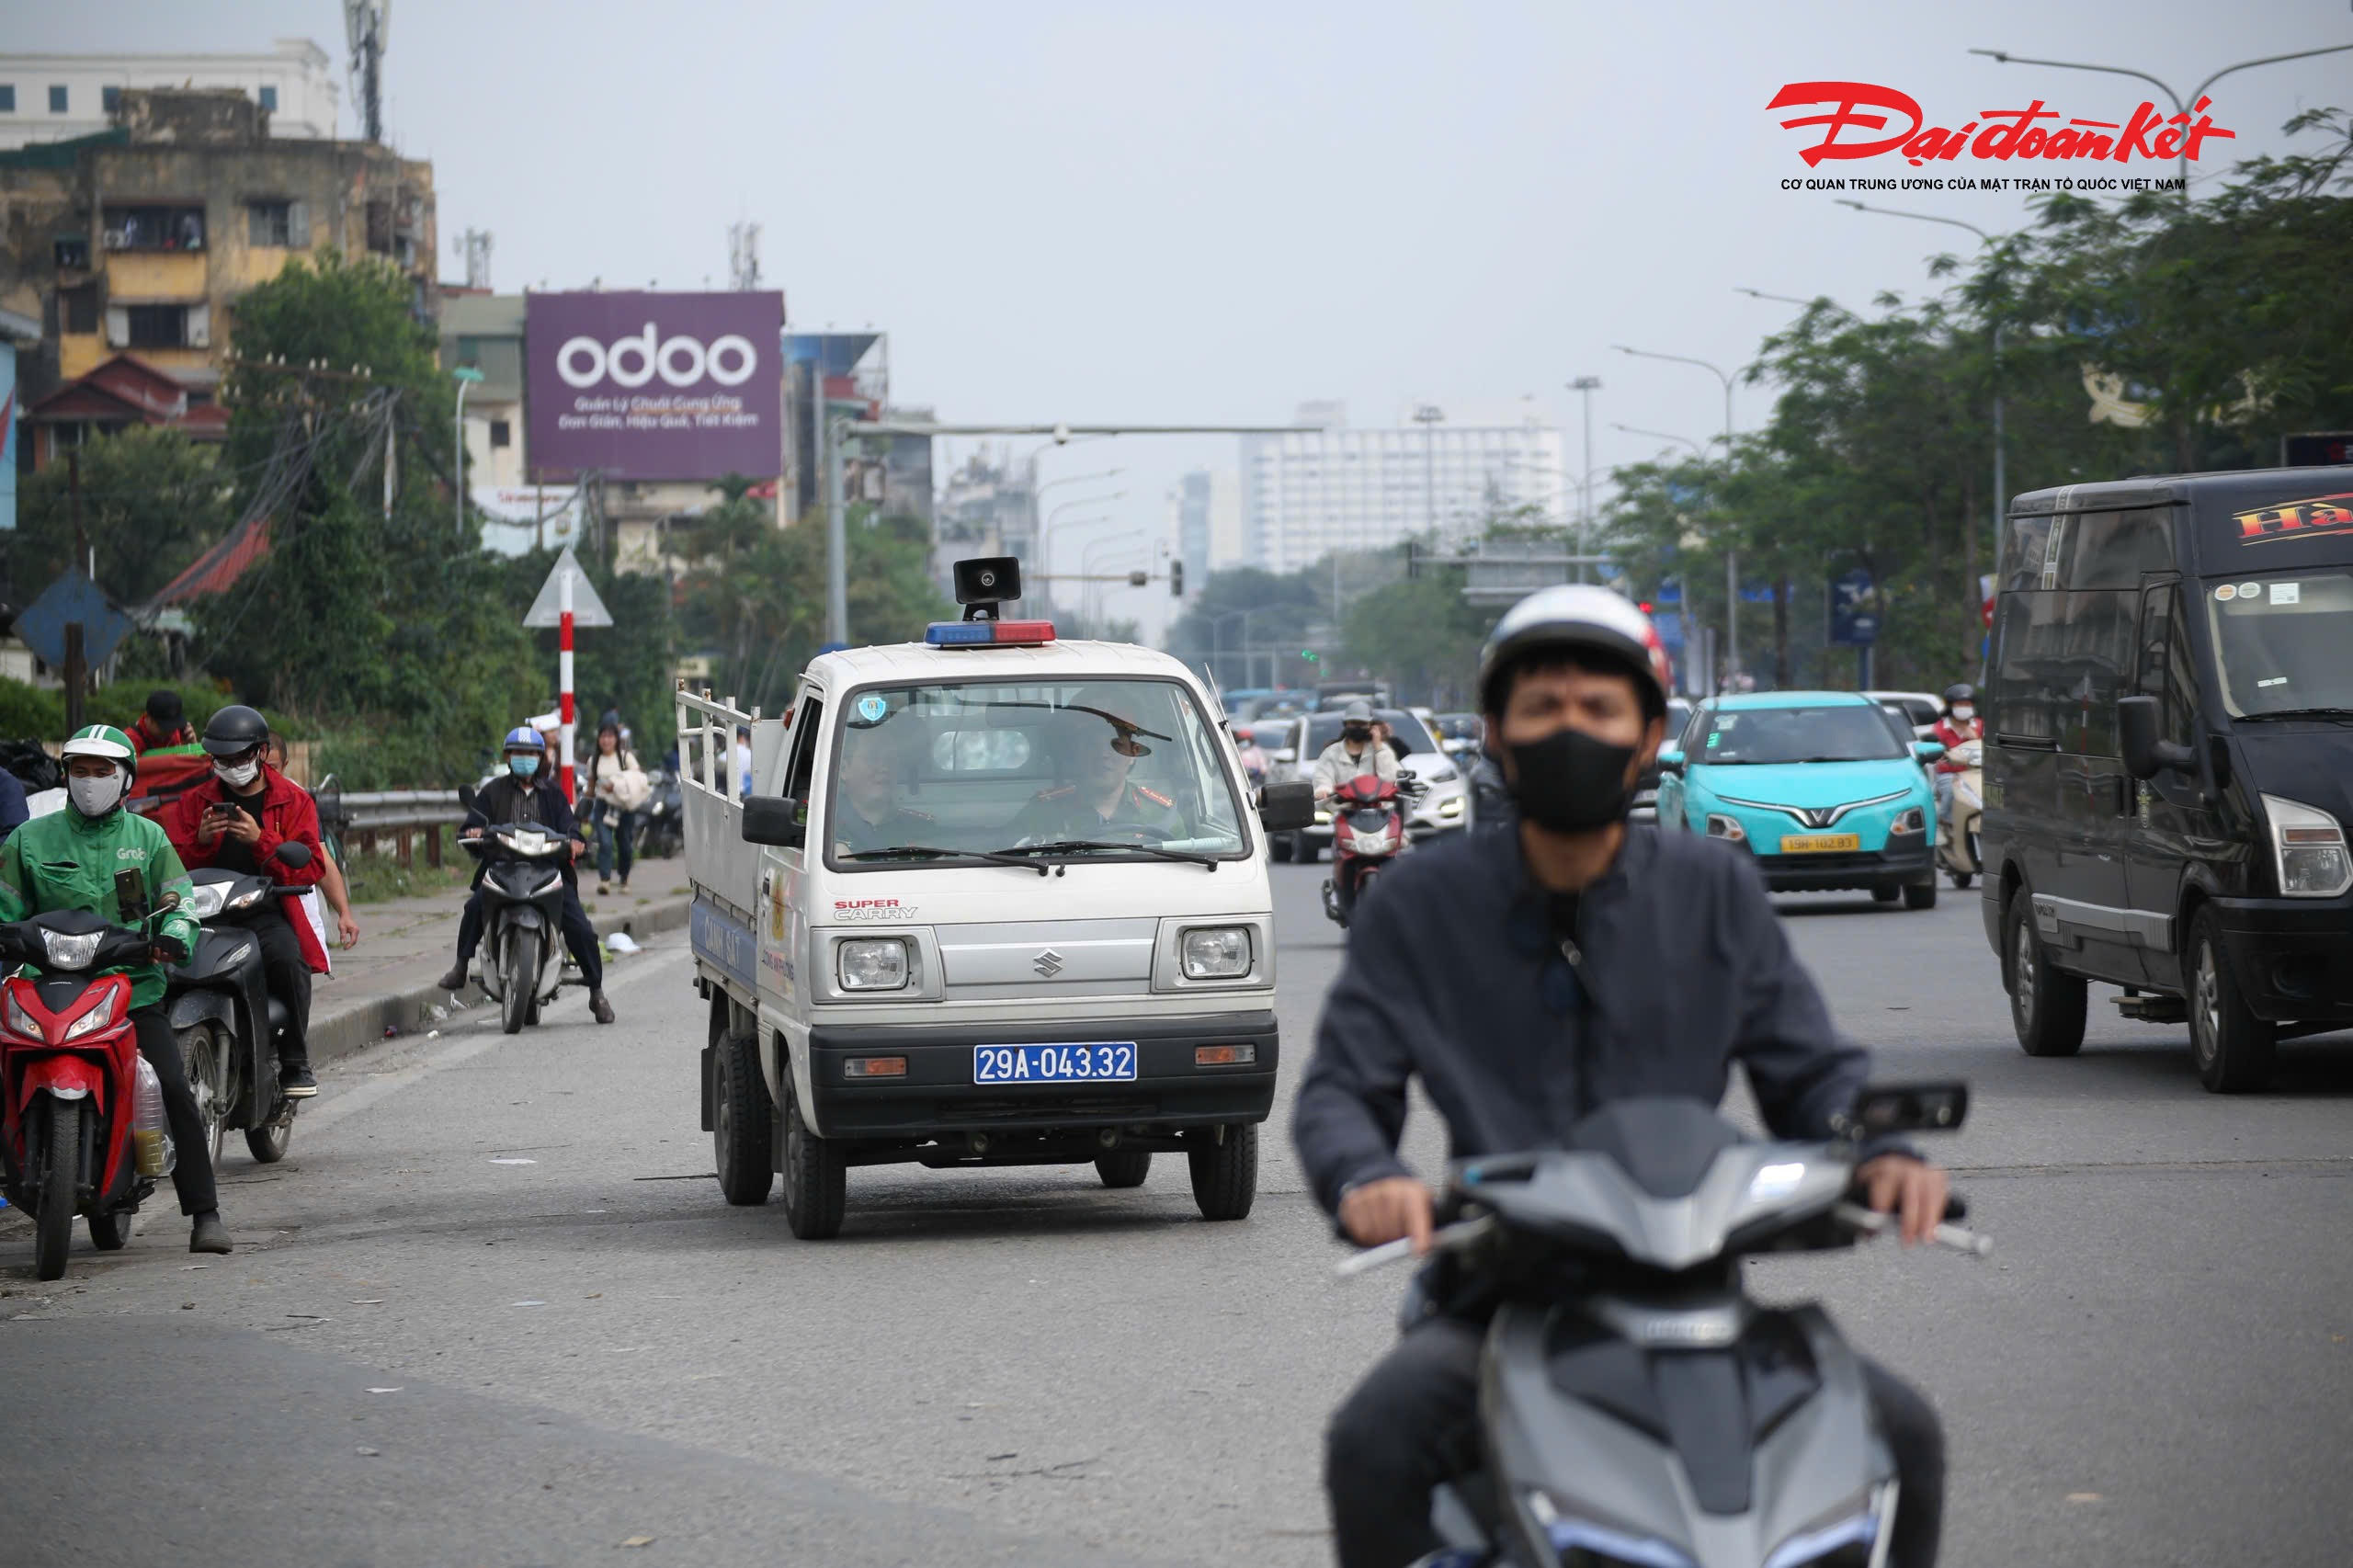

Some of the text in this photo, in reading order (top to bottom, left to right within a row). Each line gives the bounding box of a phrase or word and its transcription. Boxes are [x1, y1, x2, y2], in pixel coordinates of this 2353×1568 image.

[556, 321, 757, 389] odoo
[116, 847, 147, 861] Grab
[834, 899, 900, 910] SUPER
[833, 906, 918, 921] CARRY
[978, 1046, 1132, 1080] 29A-043.32
